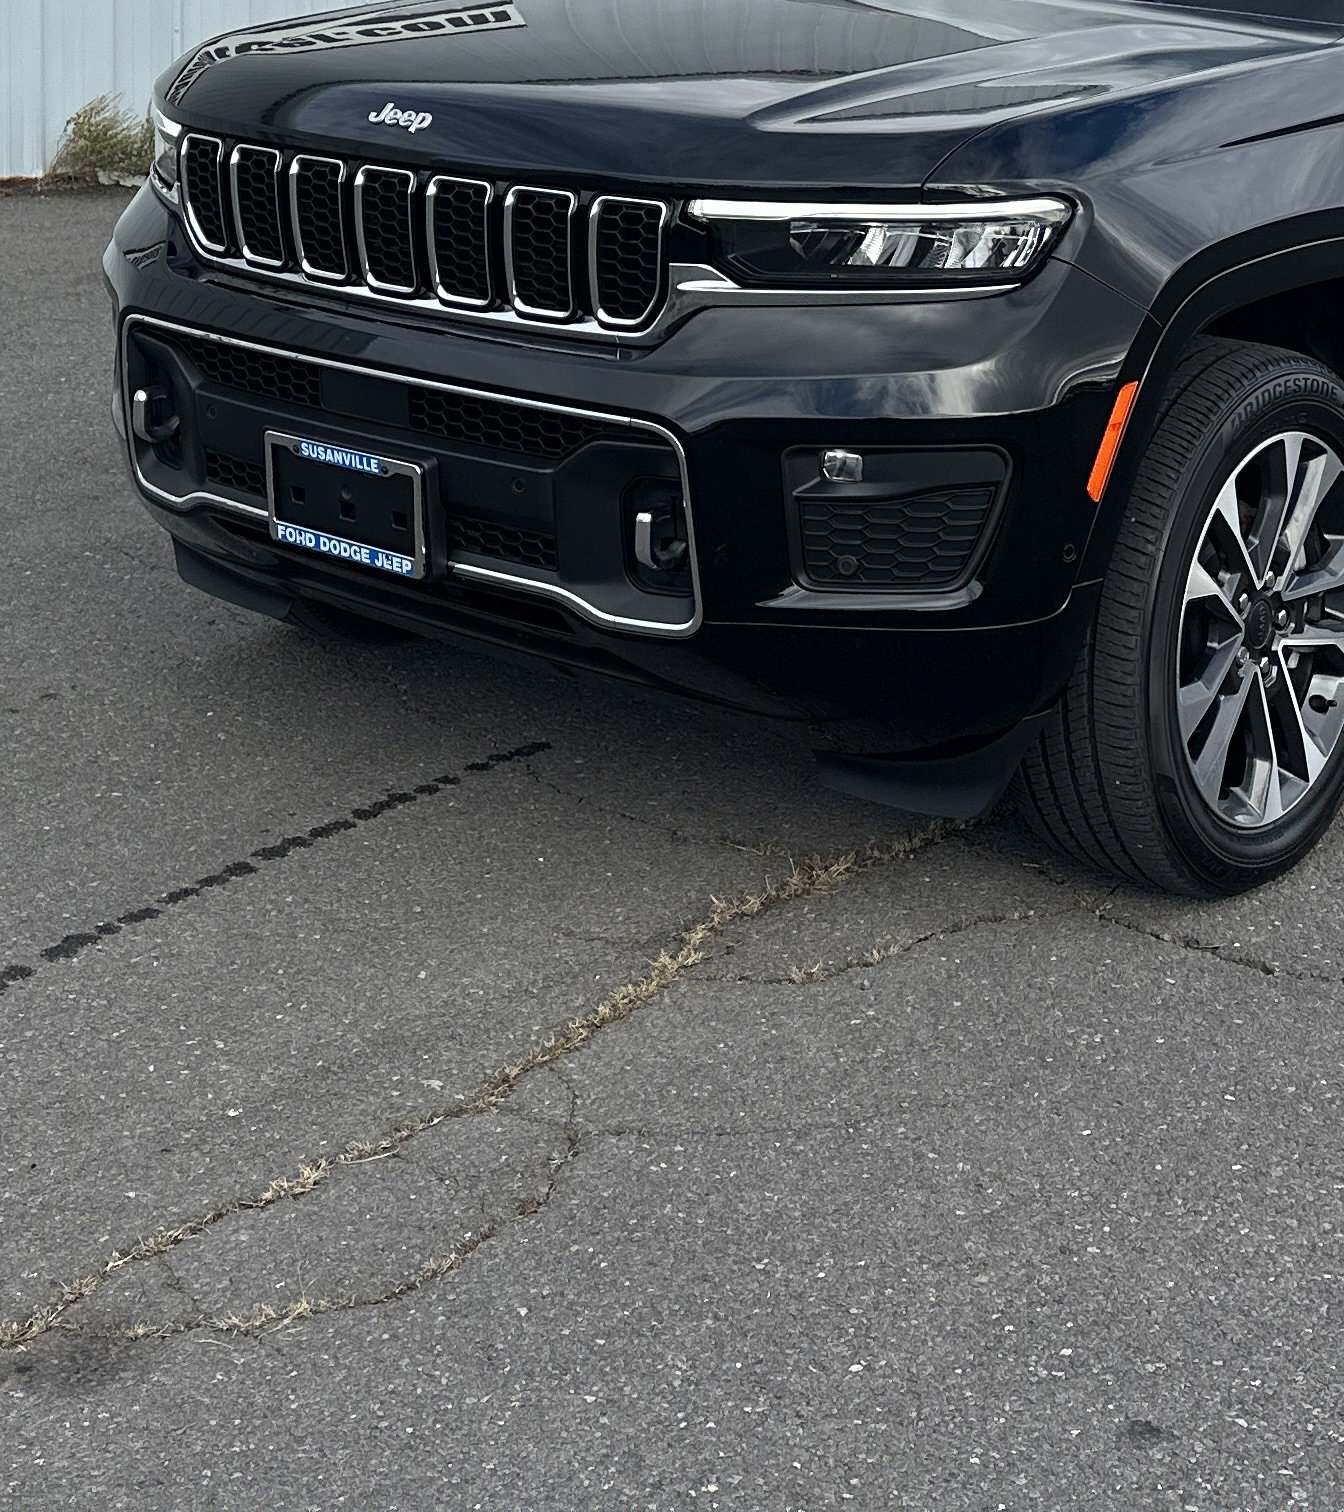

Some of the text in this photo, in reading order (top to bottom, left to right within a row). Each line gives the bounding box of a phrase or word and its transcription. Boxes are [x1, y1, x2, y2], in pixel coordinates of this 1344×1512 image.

[368, 102, 433, 134] Jeep
[1230, 377, 1339, 428] BRIDGESTONE
[300, 441, 380, 473] SUSANVILLE
[277, 524, 413, 574] FORD DODGE JEEP
